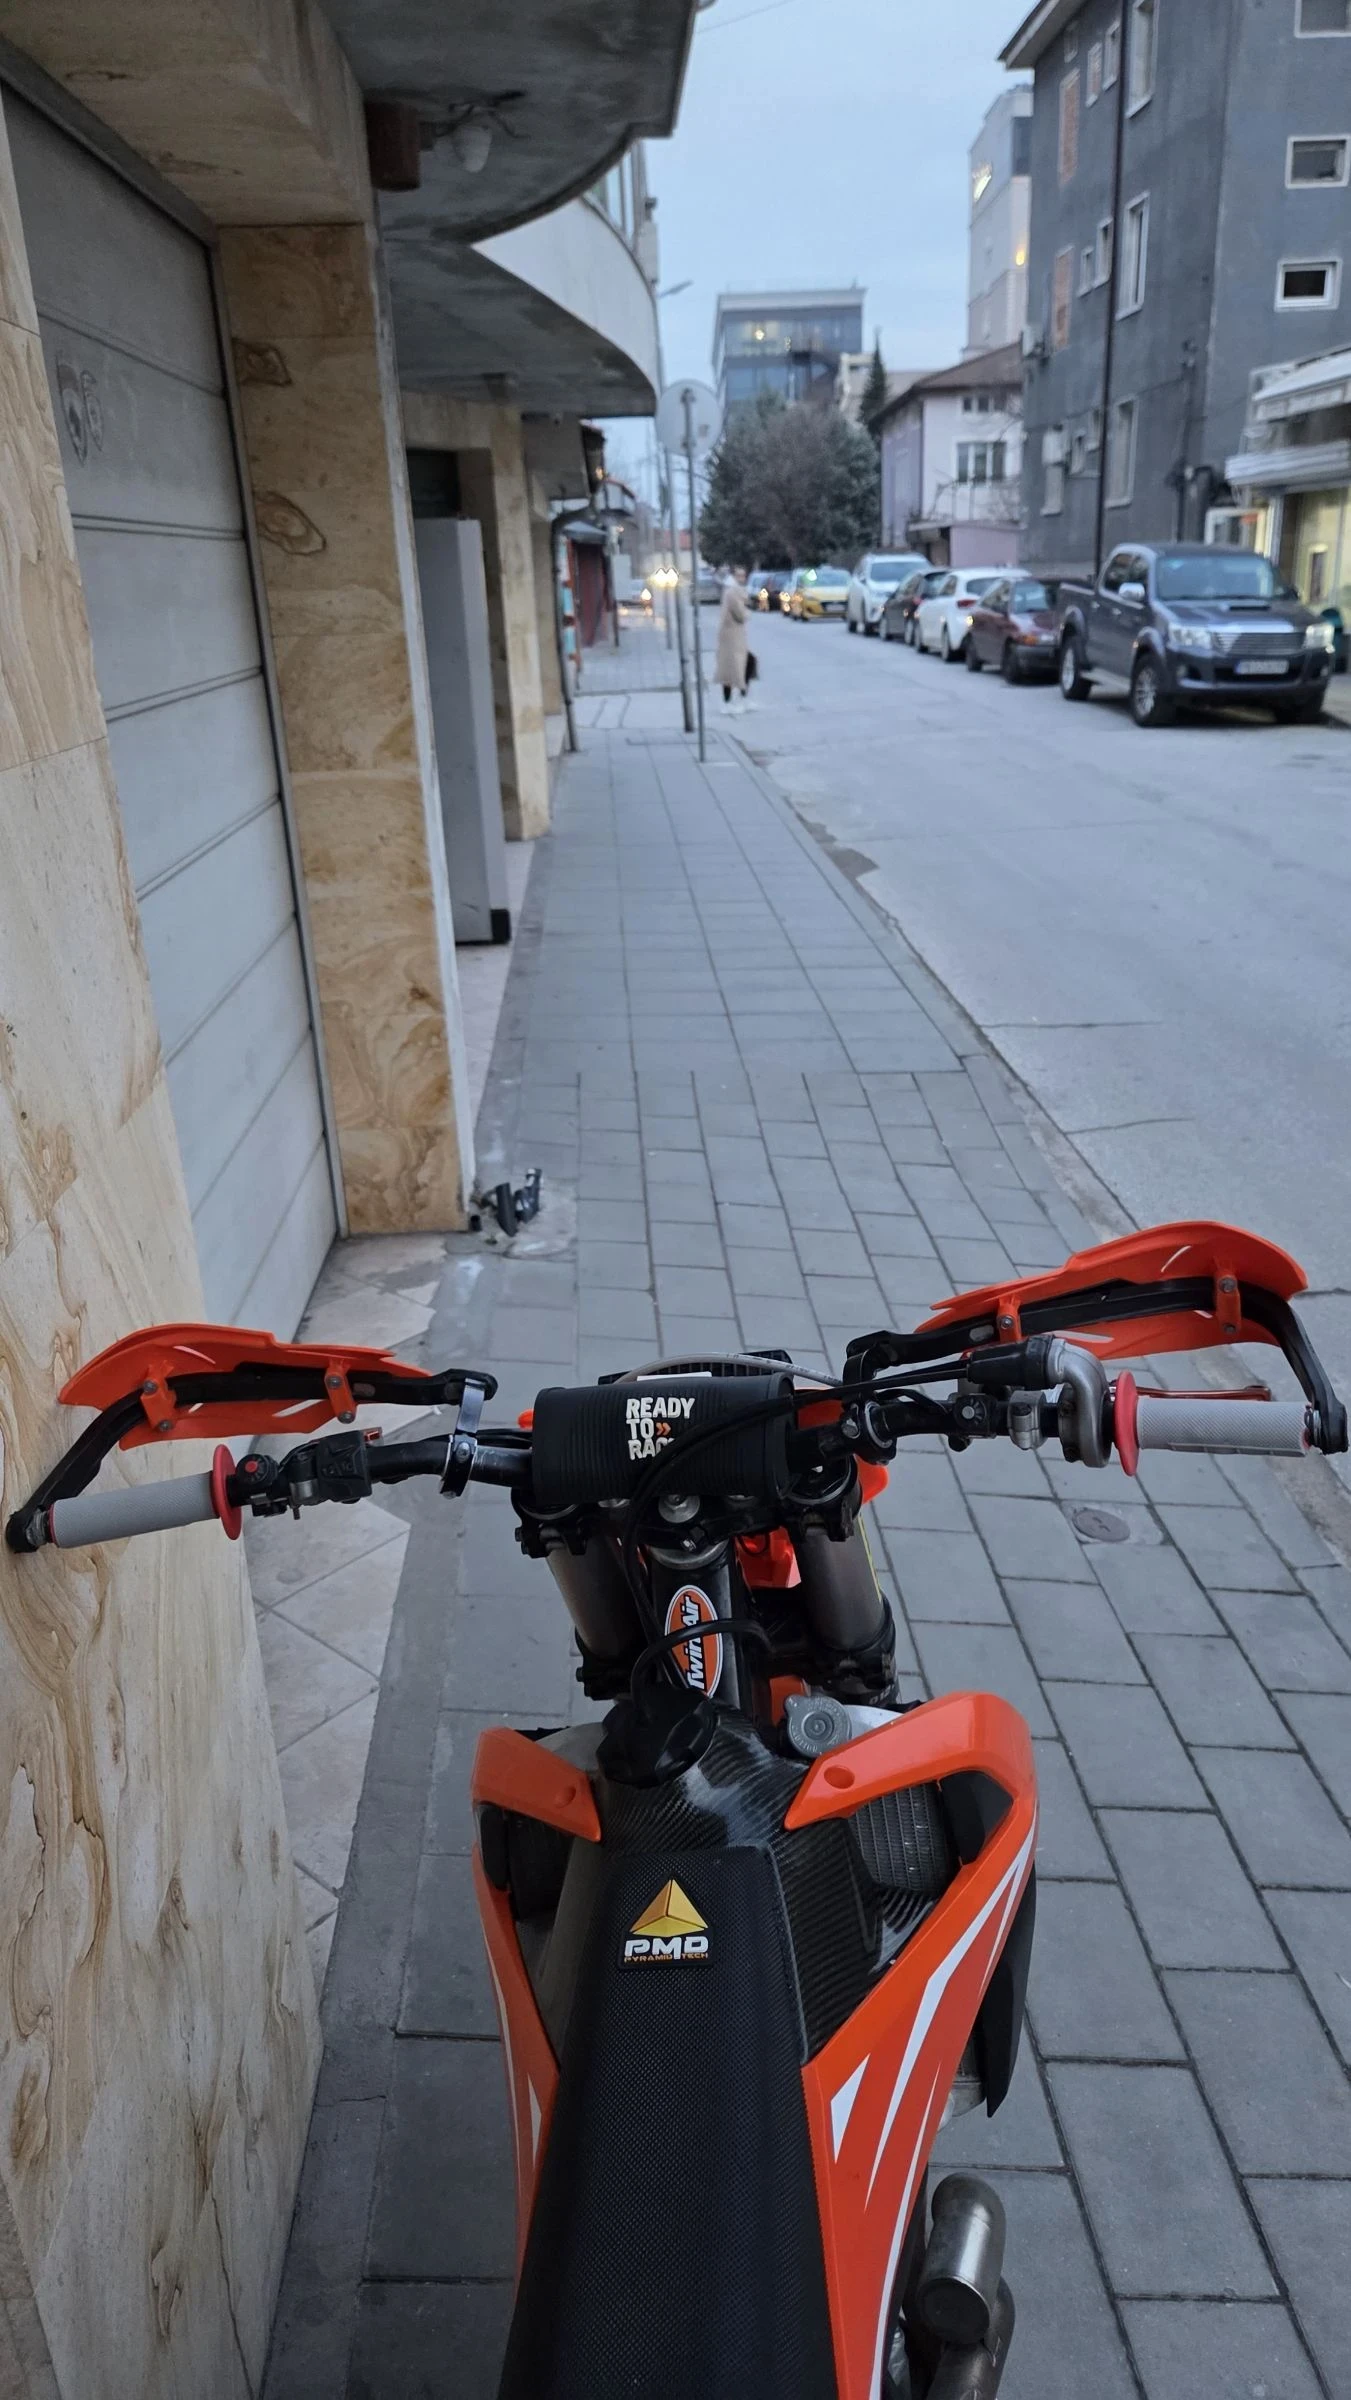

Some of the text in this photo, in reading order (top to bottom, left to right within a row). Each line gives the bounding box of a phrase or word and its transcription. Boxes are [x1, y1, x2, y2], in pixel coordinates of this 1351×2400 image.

[626, 1396, 696, 1419] READY
[626, 1417, 655, 1440] TO
[624, 1936, 709, 1960] PMD
[624, 1952, 709, 1963] PYRAMID TECH
